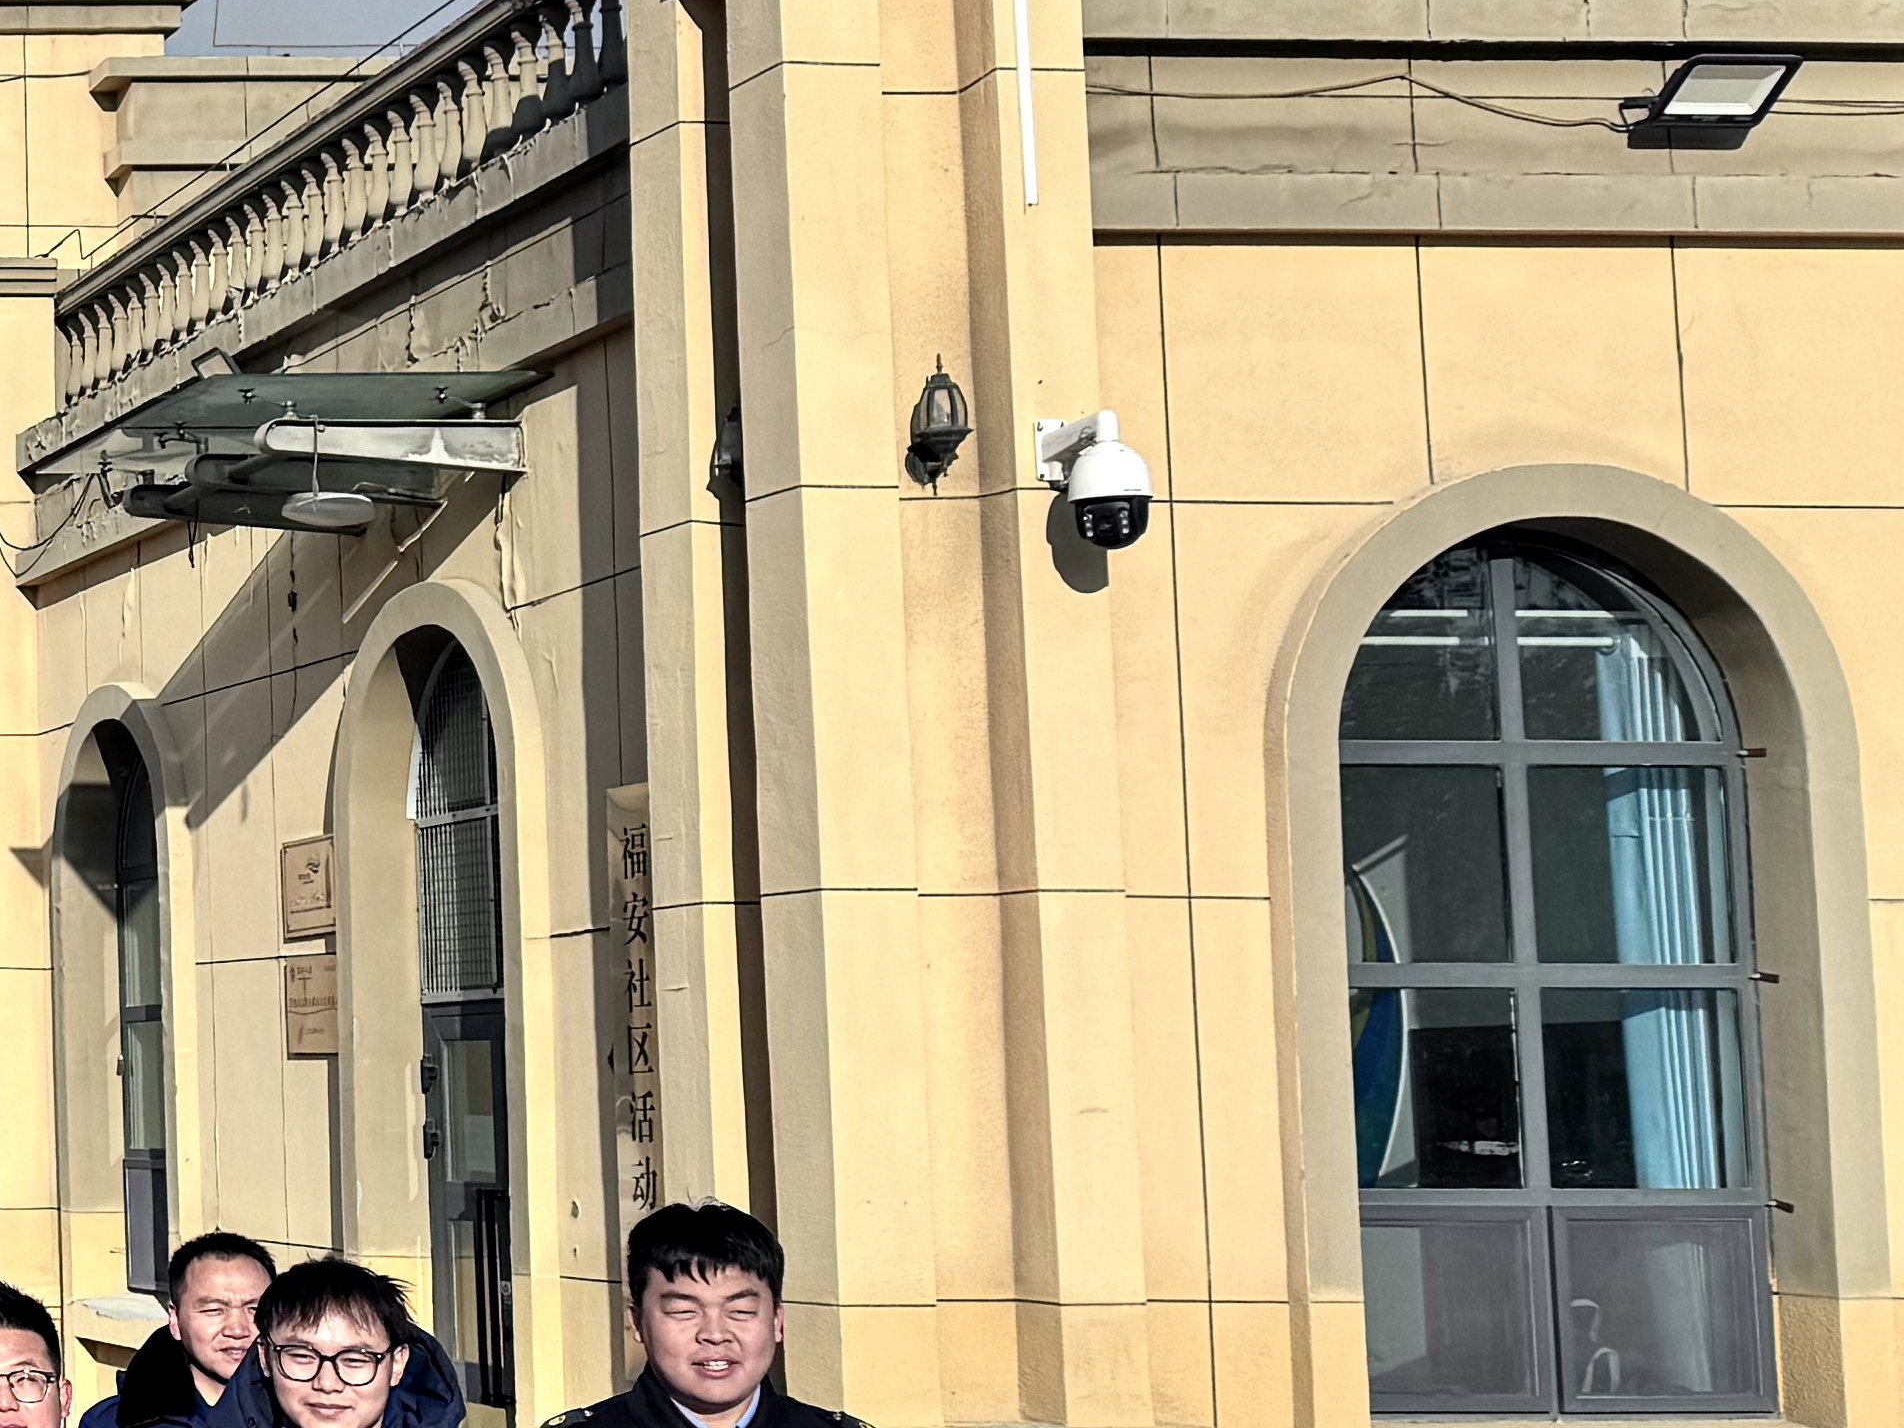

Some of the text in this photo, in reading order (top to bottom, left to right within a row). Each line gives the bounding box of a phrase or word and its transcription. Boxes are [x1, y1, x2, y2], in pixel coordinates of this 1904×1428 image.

[620, 823, 658, 1211] 福安社区活动
